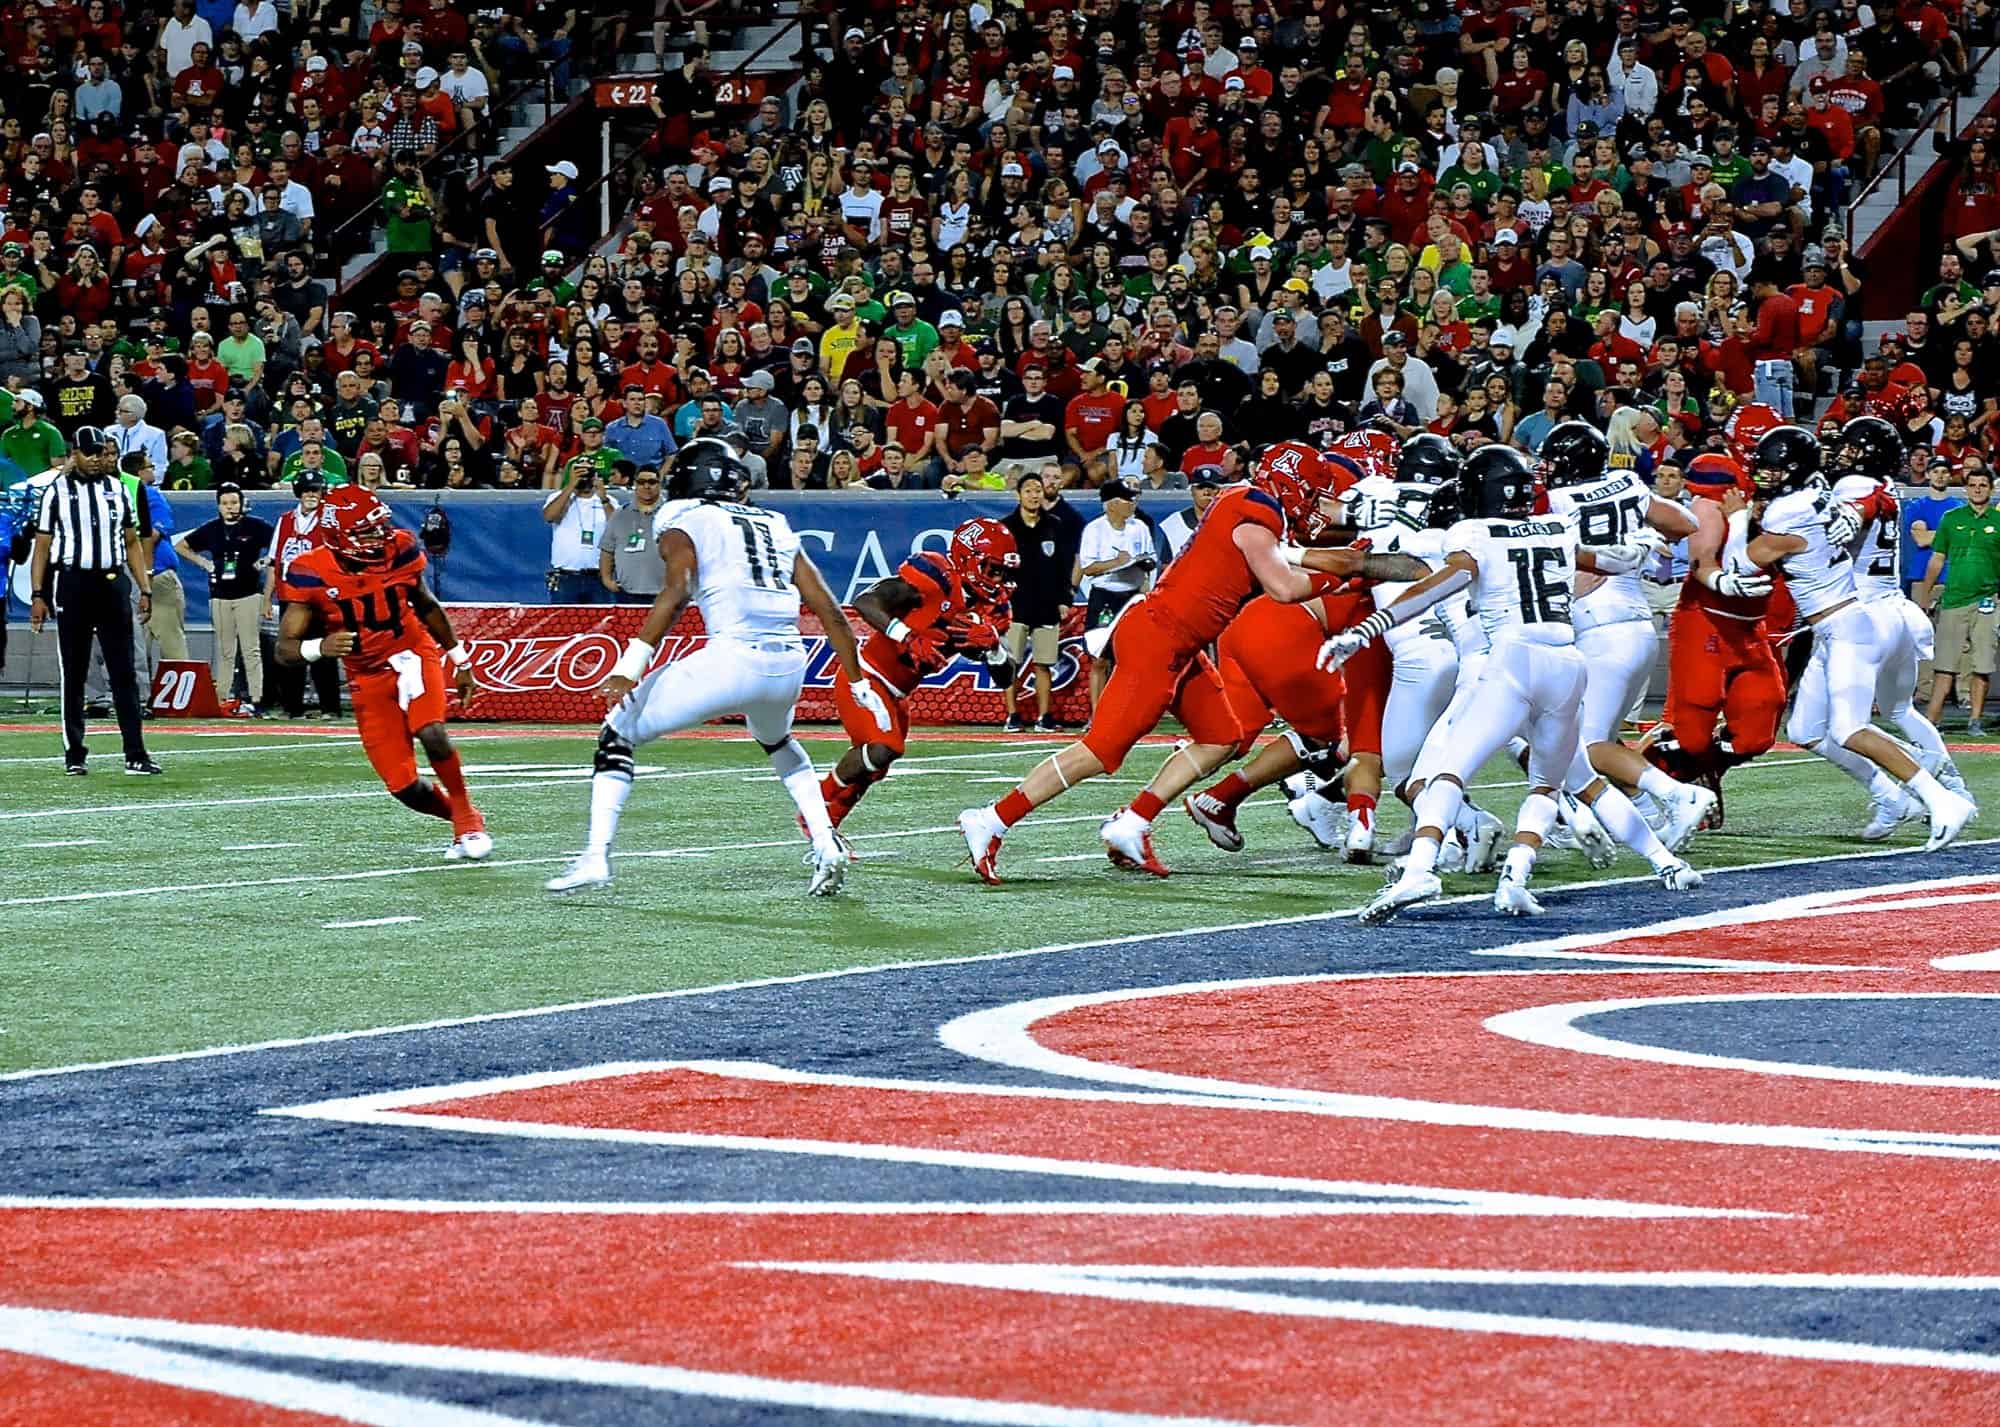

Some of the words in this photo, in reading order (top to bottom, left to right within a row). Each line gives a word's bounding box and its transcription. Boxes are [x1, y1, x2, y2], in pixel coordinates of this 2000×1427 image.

[628, 85, 646, 104] 22
[715, 83, 734, 102] 23
[824, 237, 846, 247] EAR
[1272, 449, 1303, 479] A
[956, 523, 984, 551] A
[731, 516, 788, 590] 11
[1507, 547, 1574, 625] 16
[336, 586, 404, 655] 14
[152, 670, 196, 710] 20
[1194, 792, 1226, 815] NIKE
